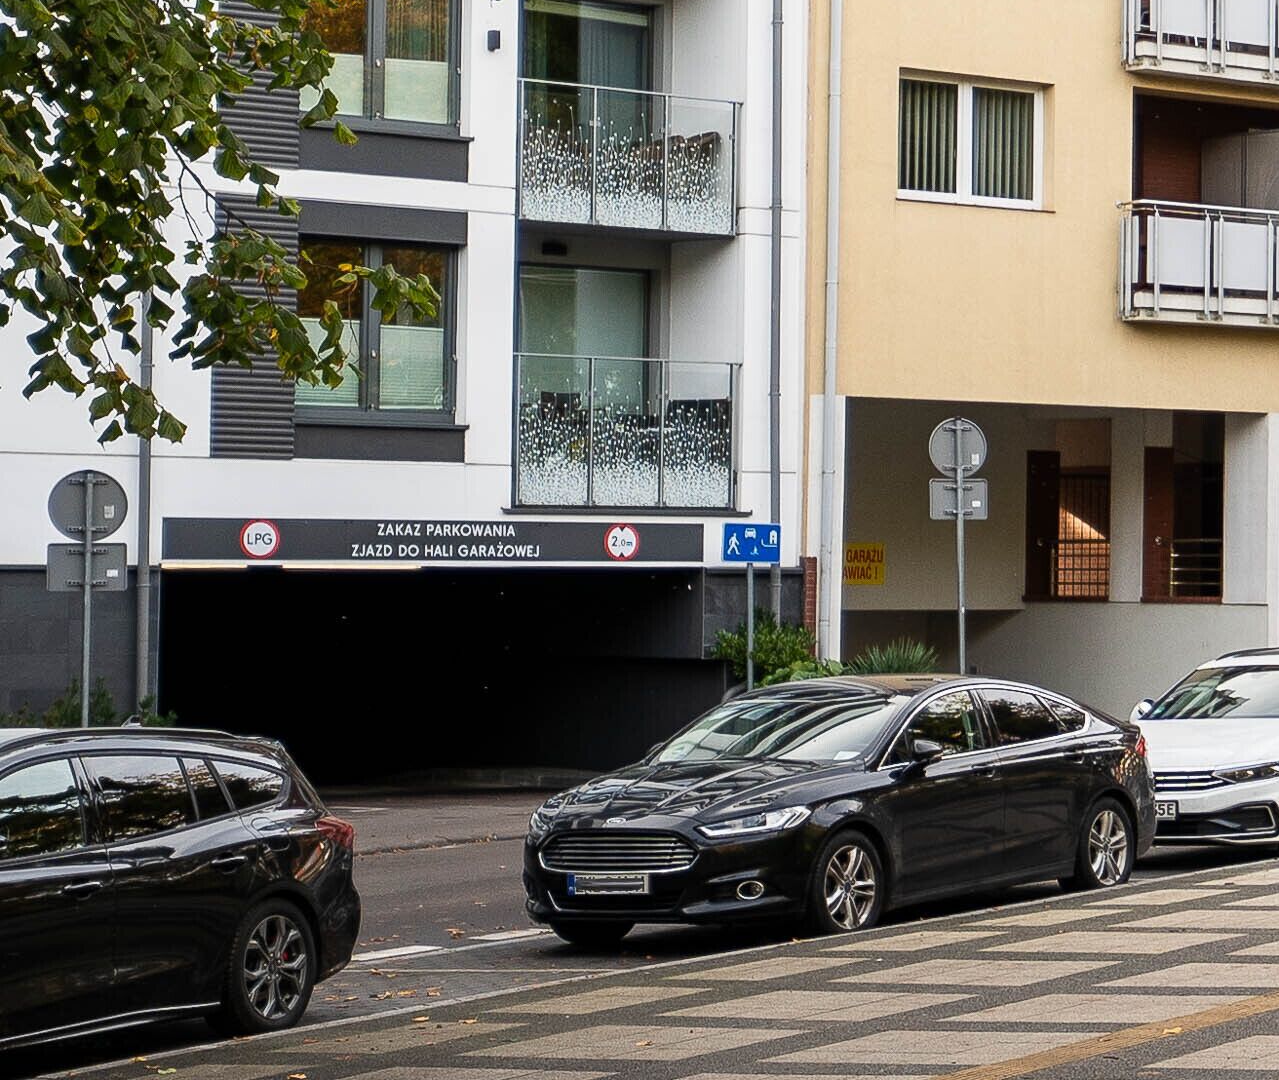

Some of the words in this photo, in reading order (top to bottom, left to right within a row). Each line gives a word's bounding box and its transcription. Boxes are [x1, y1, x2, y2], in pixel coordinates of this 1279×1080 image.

[377, 523, 421, 537] ZAKAZ
[426, 523, 516, 537] PARKOWANIA
[247, 532, 273, 545] LPG
[351, 544, 393, 557] ZJAZD
[398, 545, 420, 558] DO
[425, 545, 453, 558] HALI
[457, 542, 540, 558] GARAŻOWEJ
